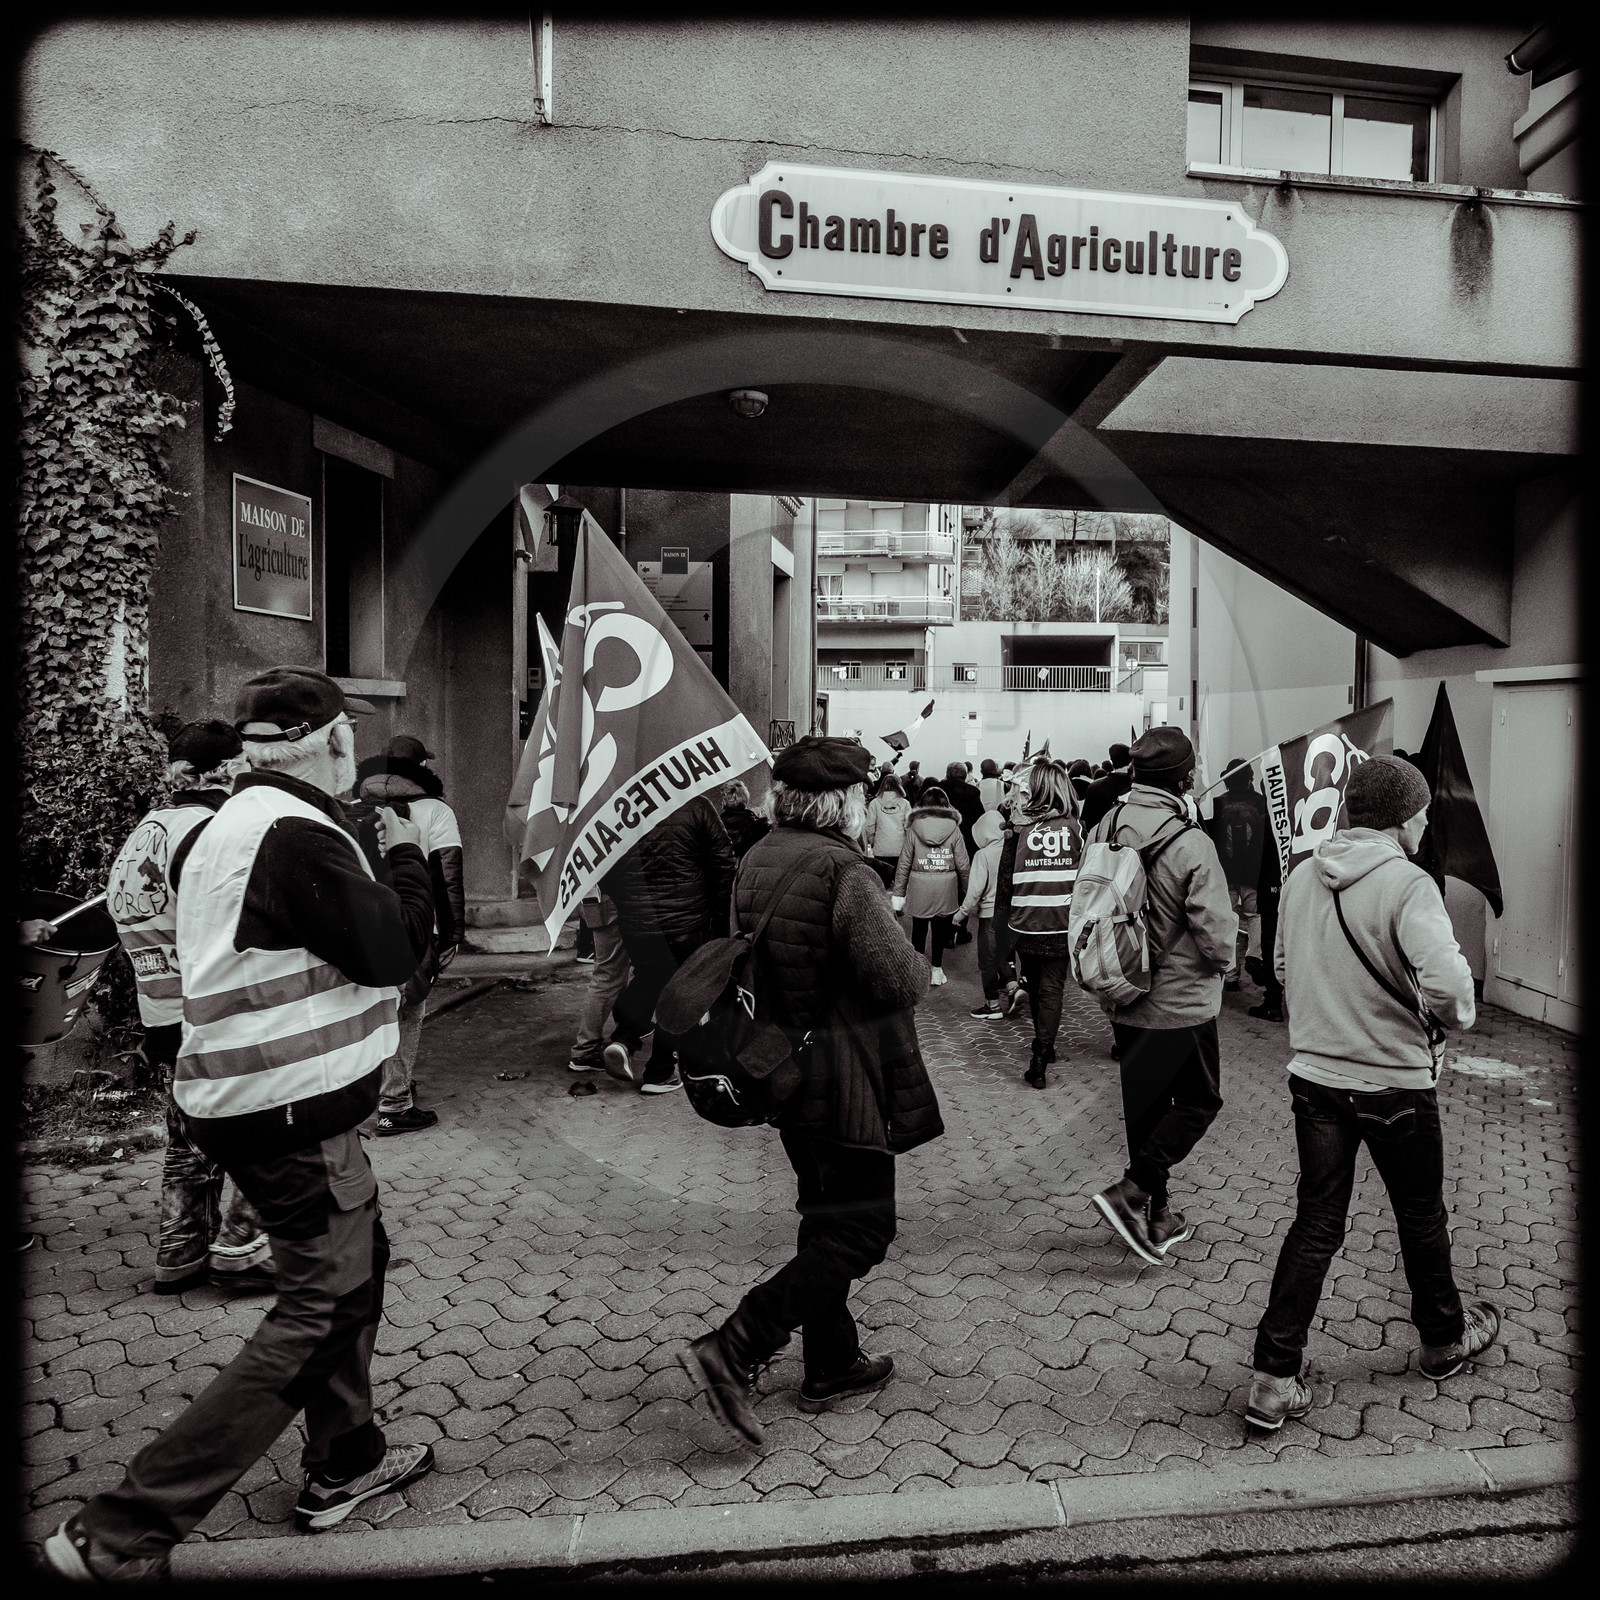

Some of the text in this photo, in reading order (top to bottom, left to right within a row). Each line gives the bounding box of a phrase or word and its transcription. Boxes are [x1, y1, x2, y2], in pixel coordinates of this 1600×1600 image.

[758, 189, 1242, 282] Chambre d'Agriculture
[240, 501, 305, 539] MAISON DE
[239, 533, 308, 581] L'agriculture
[1027, 826, 1071, 858] cgt
[1024, 857, 1073, 867] HAUTES-ALPES
[112, 890, 166, 915] ORCE
